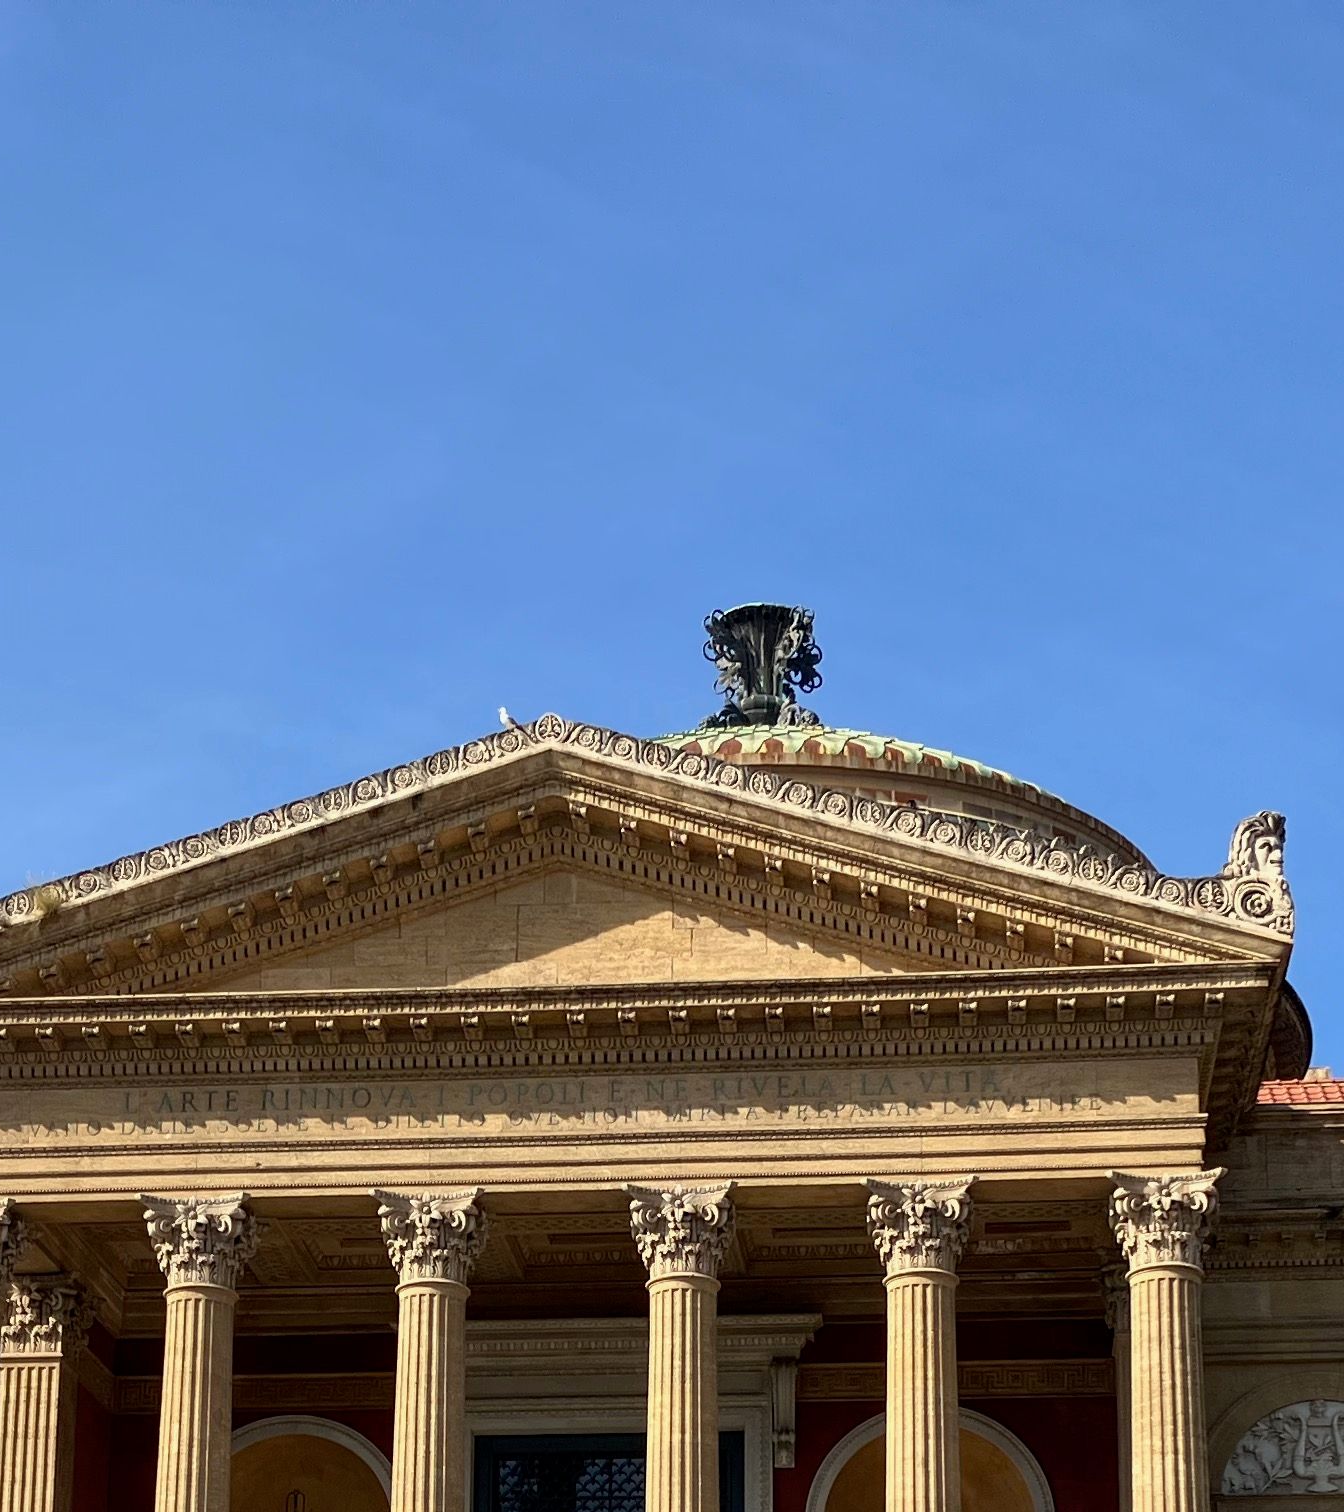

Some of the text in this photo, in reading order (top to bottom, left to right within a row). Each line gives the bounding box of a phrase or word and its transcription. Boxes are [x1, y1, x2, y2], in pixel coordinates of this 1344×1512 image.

[260, 1086, 418, 1112] RINNOVA
[467, 1081, 586, 1107] POPOLI
[712, 1075, 838, 1100] RIVELA
[859, 1073, 898, 1096] LA
[918, 1068, 1001, 1093] VITA
